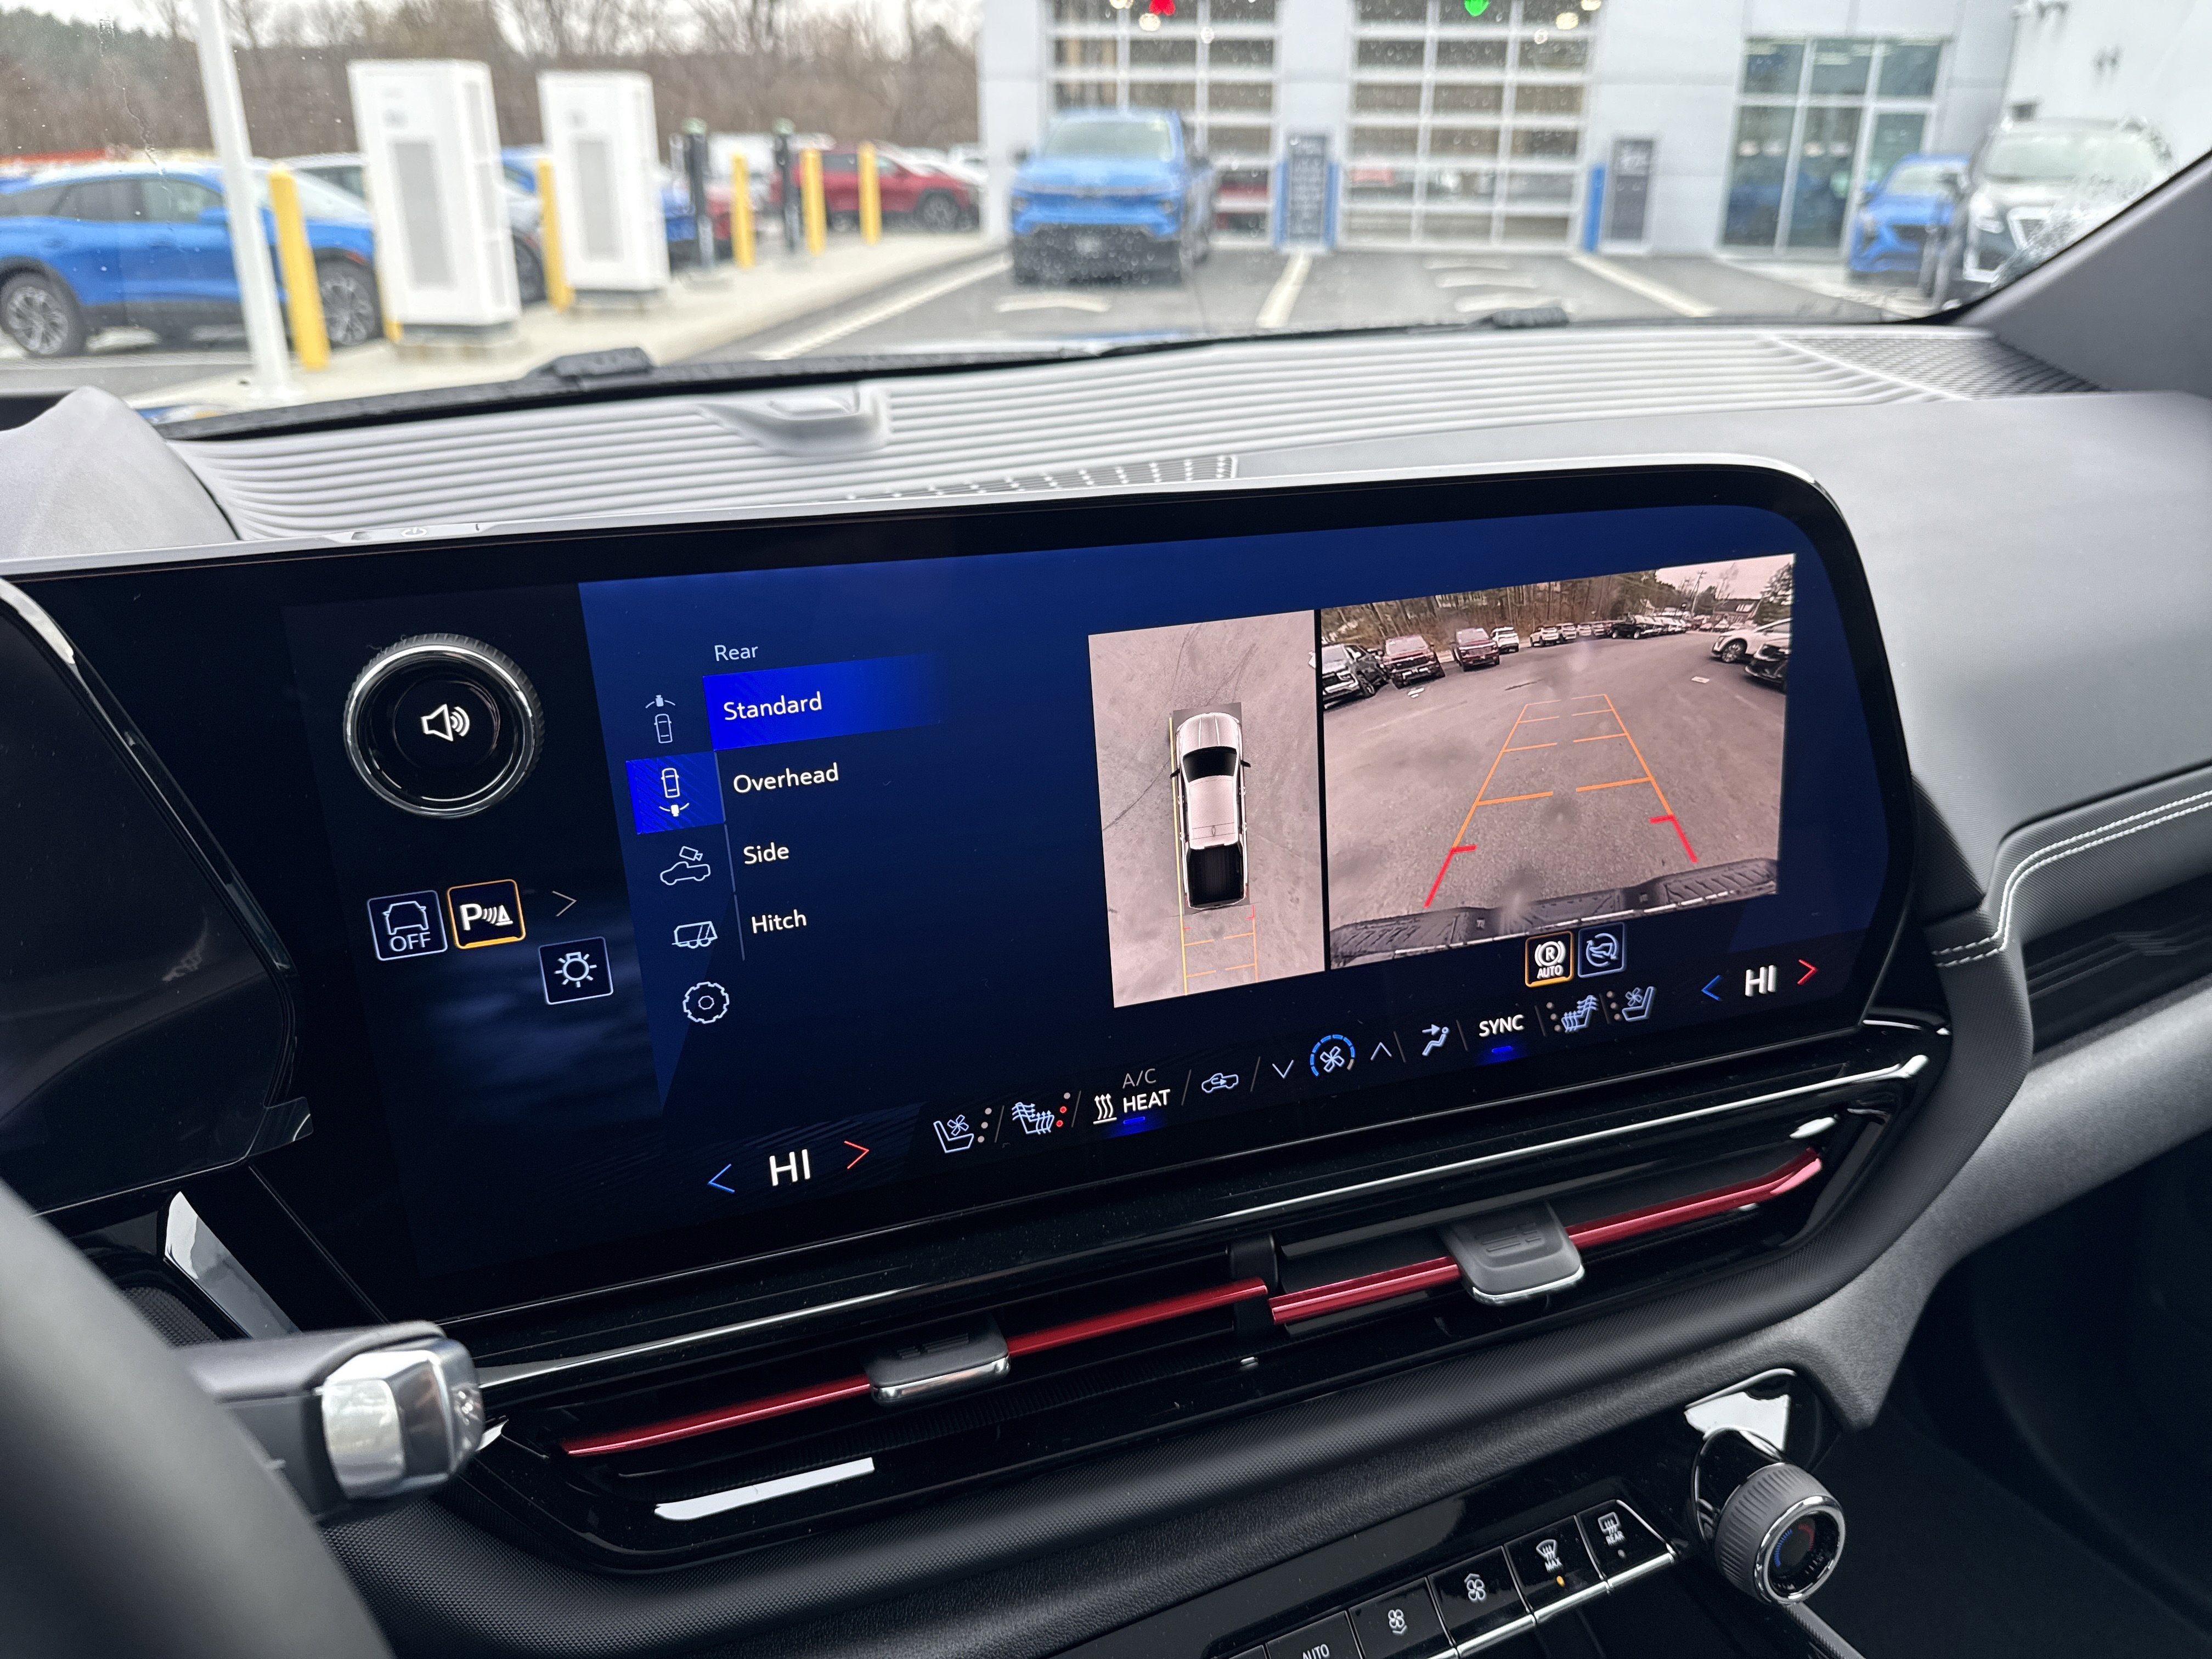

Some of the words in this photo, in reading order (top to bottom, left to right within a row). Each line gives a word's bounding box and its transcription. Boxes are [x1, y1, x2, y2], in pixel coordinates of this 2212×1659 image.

[714, 644, 759, 662] Rear
[723, 691, 822, 720] Standard
[733, 762, 839, 793] Overhead
[743, 842, 789, 864] Side
[751, 909, 807, 934] Hitch
[390, 932, 431, 952] OFF
[1537, 964, 1564, 979] AUTO
[1745, 964, 1778, 997] HI
[1479, 1014, 1525, 1037] SYNC
[1122, 1068, 1157, 1089] A/C
[1123, 1088, 1171, 1113] HEAT
[769, 1149, 811, 1187] HI
[1605, 1531, 1627, 1547] REAR
[1544, 1557, 1564, 1573] MAX
[1302, 1644, 1330, 1659] AUTO
